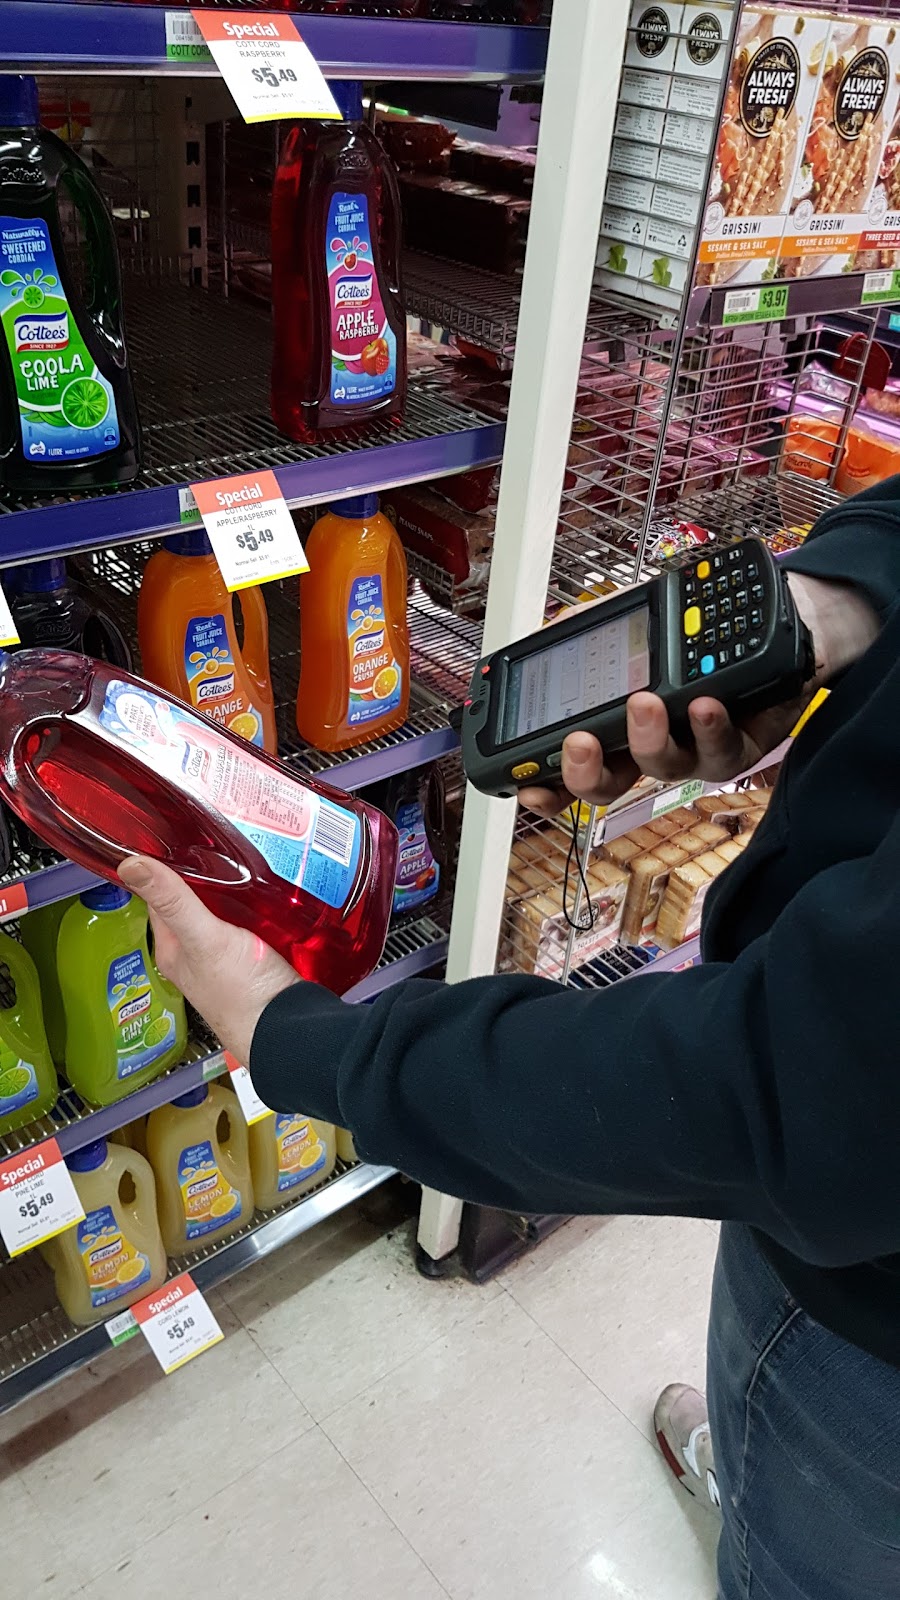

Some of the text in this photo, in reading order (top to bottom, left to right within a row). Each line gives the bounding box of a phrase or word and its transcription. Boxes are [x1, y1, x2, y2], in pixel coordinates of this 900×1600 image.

[223, 22, 280, 38] Special
[691, 28, 719, 40] ALWAYS
[171, 45, 195, 56] COTT
[252, 68, 298, 87] $5.49
[748, 71, 796, 88] ALWAYS
[842, 78, 885, 94] ALWAYS
[748, 88, 788, 104] FRESH
[841, 94, 877, 110] FRESH
[335, 212, 364, 225] FRUIT JUICE
[810, 220, 844, 231] GRISSINI
[2, 229, 41, 240] Naturally
[722, 222, 761, 235] GRISSINI
[2, 240, 46, 255] SWEETENED
[707, 242, 730, 252] SESAME
[740, 241, 750, 250] SEA
[752, 240, 767, 249] SALT
[795, 238, 816, 246] SESAME
[8, 253, 36, 264] CORDIAL
[338, 284, 370, 298] Cottee's
[762, 290, 786, 308] $3.97
[336, 310, 374, 331] APPLE
[18, 324, 67, 340] Cottee's
[340, 325, 378, 340] RASPBERRY
[20, 354, 84, 378] COOLA
[26, 376, 60, 390] LIME
[216, 483, 264, 508] Special
[225, 502, 262, 515] COTT CORD
[216, 508, 277, 528] APPLE/RASPBERRY
[399, 517, 434, 541] PEANUT SNAPS
[236, 528, 274, 552] $5.49
[192, 628, 222, 643] FRUIT JUICE
[356, 637, 382, 652] Cottee's
[353, 652, 388, 676] ORANGE
[354, 668, 374, 683] CRUSH
[199, 682, 232, 698] Cottee's
[201, 698, 242, 718] RANGE
[188, 749, 203, 778] Cottee's
[400, 856, 426, 876] APPLE
[120, 1000, 149, 1018] Cottee's
[122, 1012, 151, 1037] PINE
[124, 1028, 142, 1042] LIME
[282, 1138, 312, 1160] LEMON
[2, 1154, 45, 1185] Special
[27, 1172, 44, 1183] CORD
[15, 1180, 44, 1198] PINE LIME
[20, 1193, 54, 1217] $5.49
[188, 1188, 223, 1207] LEMON
[92, 1253, 128, 1276] LEMON
[148, 1286, 184, 1314] Special
[172, 1304, 190, 1317] LEMON
[167, 1316, 195, 1340] $5.49
